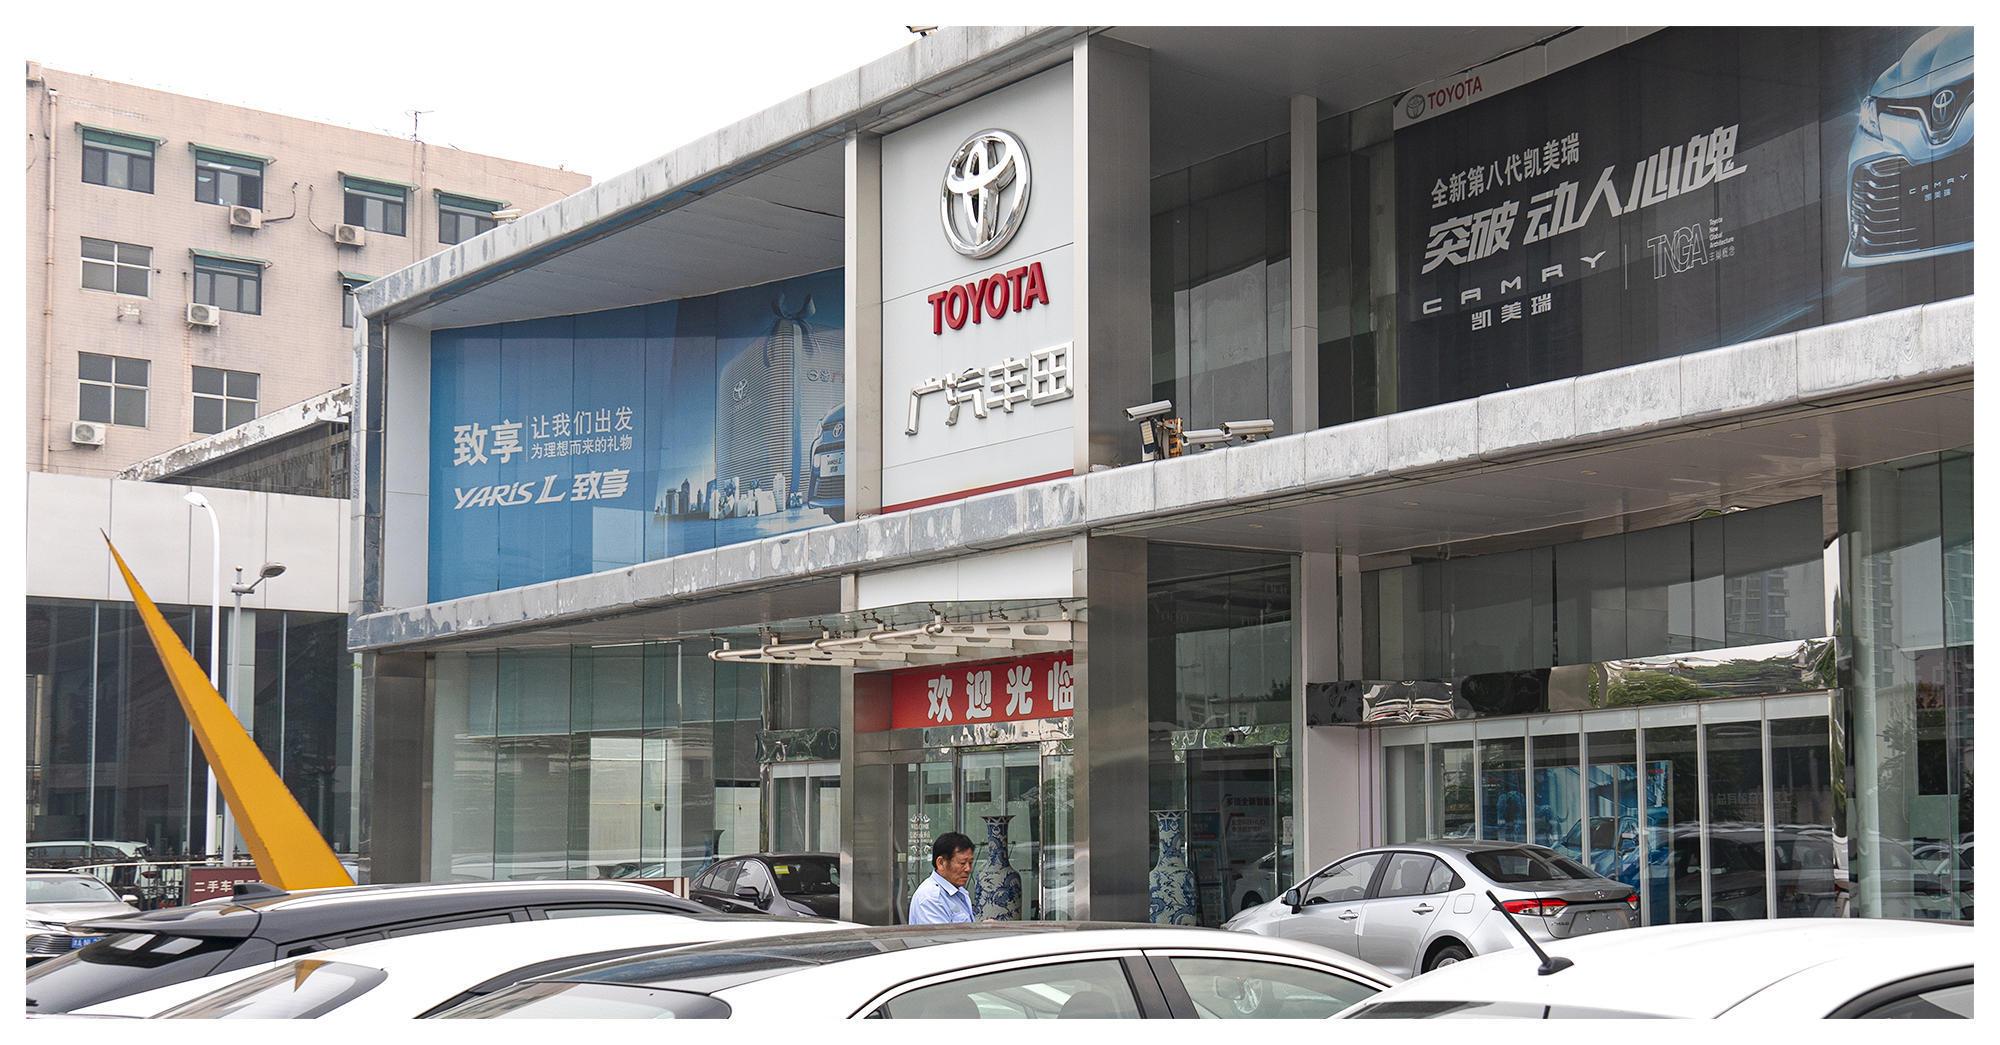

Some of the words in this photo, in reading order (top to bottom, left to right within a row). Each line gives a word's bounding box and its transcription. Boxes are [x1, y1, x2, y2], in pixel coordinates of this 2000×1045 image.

[1428, 76, 1483, 109] TOYOTA
[1431, 131, 1580, 208] 全新第八代凯美瑞
[1421, 200, 1520, 275] 突破
[1522, 123, 1748, 245] 动人心魄
[1646, 223, 1708, 280] TNGA
[928, 261, 1049, 335] TOYOTA
[1423, 250, 1606, 315] CAMRY
[1471, 292, 1552, 331] 凯美瑞
[904, 341, 1074, 436] 广汽丰田
[453, 418, 523, 466] 致享
[530, 405, 633, 440] 让我们出发
[530, 434, 633, 460] 为理想而来的礼物
[534, 474, 567, 504] L
[570, 468, 631, 502] 致享
[927, 661, 1074, 723] 欢迎光临
